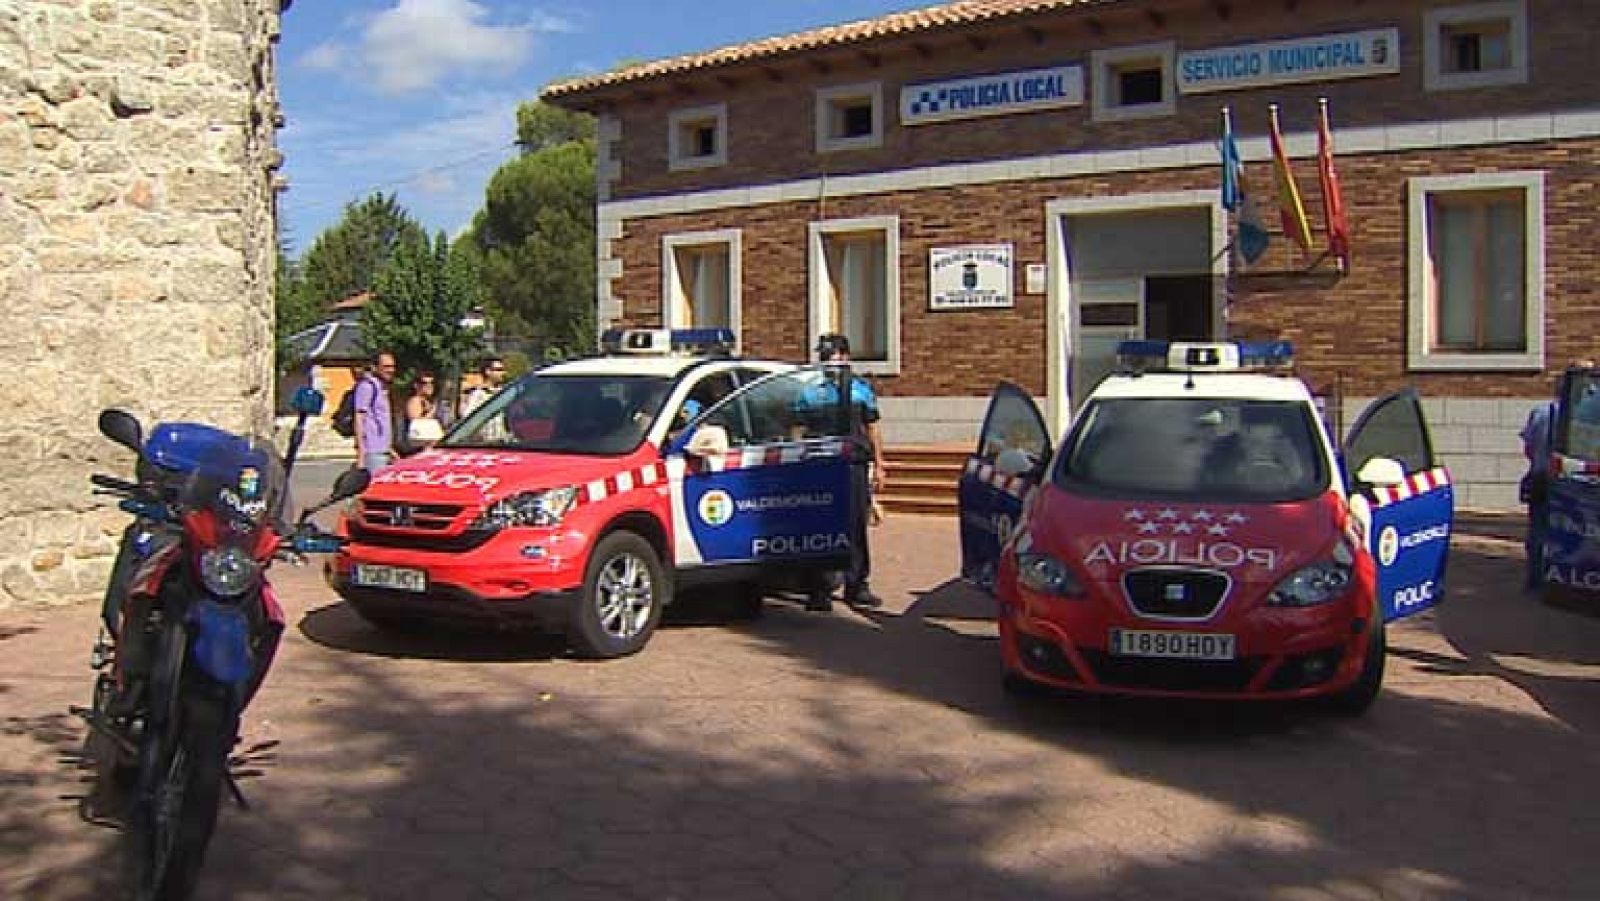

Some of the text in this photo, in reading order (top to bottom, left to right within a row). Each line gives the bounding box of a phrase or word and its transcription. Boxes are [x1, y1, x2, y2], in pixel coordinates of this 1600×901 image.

[1182, 40, 1366, 83] SERVICIO MUNICIPAL
[949, 74, 1067, 110] POLICIA LOCAL
[751, 533, 851, 557] POLICIA
